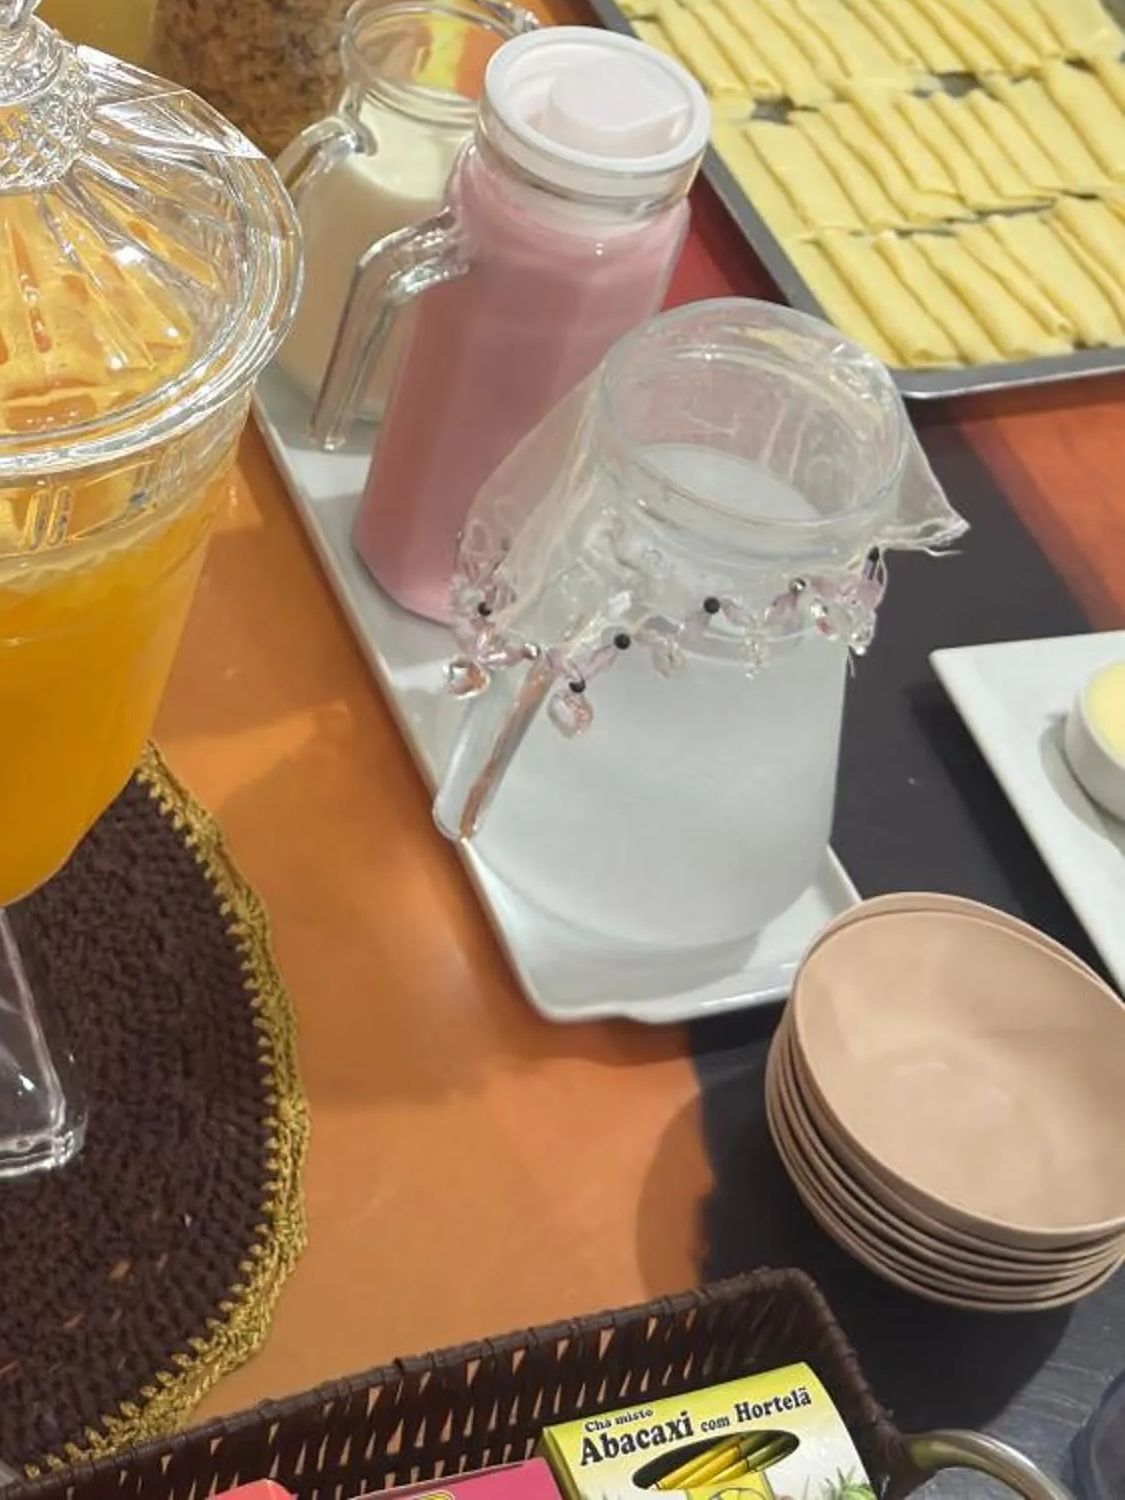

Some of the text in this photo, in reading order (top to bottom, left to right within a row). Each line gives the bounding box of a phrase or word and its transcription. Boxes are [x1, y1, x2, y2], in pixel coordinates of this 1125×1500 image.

[580, 1387, 812, 1466] Abacaxi com Hortelã
[615, 1409, 653, 1425] misto
